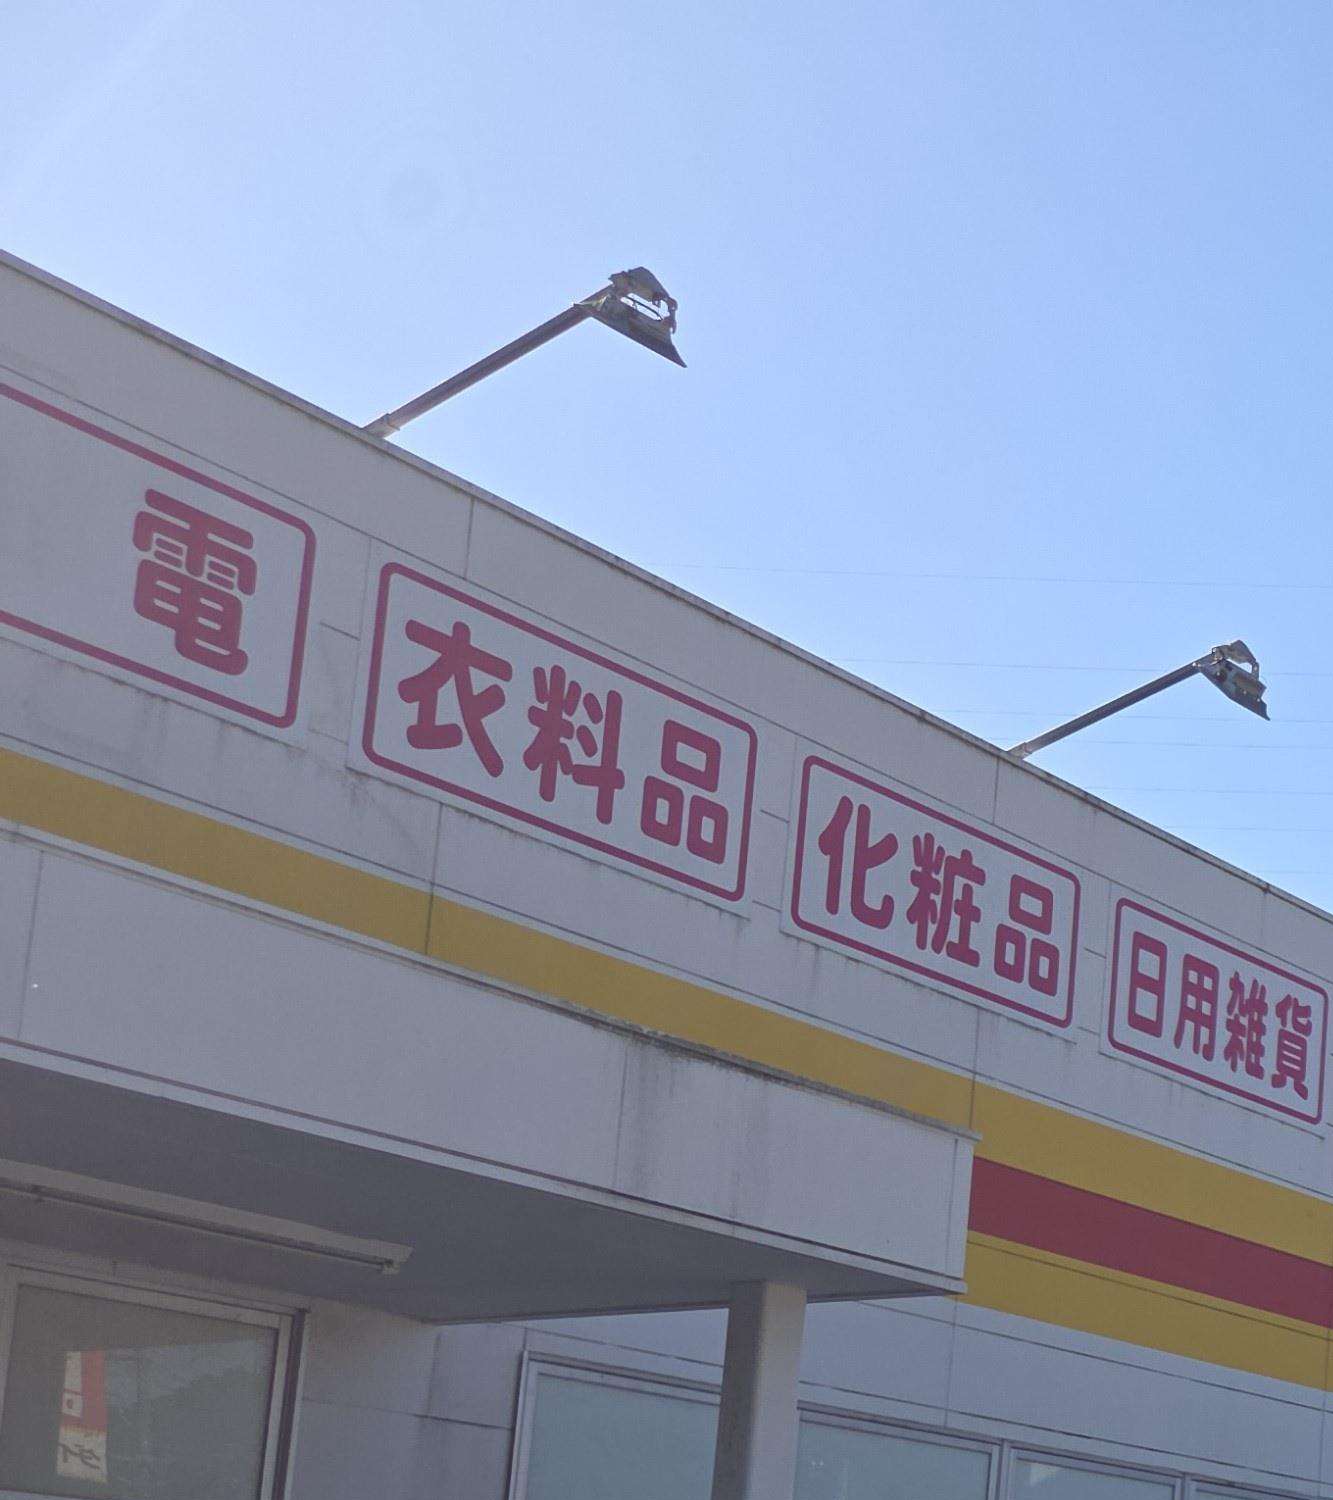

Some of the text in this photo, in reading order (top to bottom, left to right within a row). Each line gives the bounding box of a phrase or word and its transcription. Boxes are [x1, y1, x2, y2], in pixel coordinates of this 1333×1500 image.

[133, 488, 257, 675] 電
[398, 620, 729, 866] 衣料品
[818, 795, 1061, 998] 化粧品
[1127, 931, 1312, 1100] 日用雑貨
